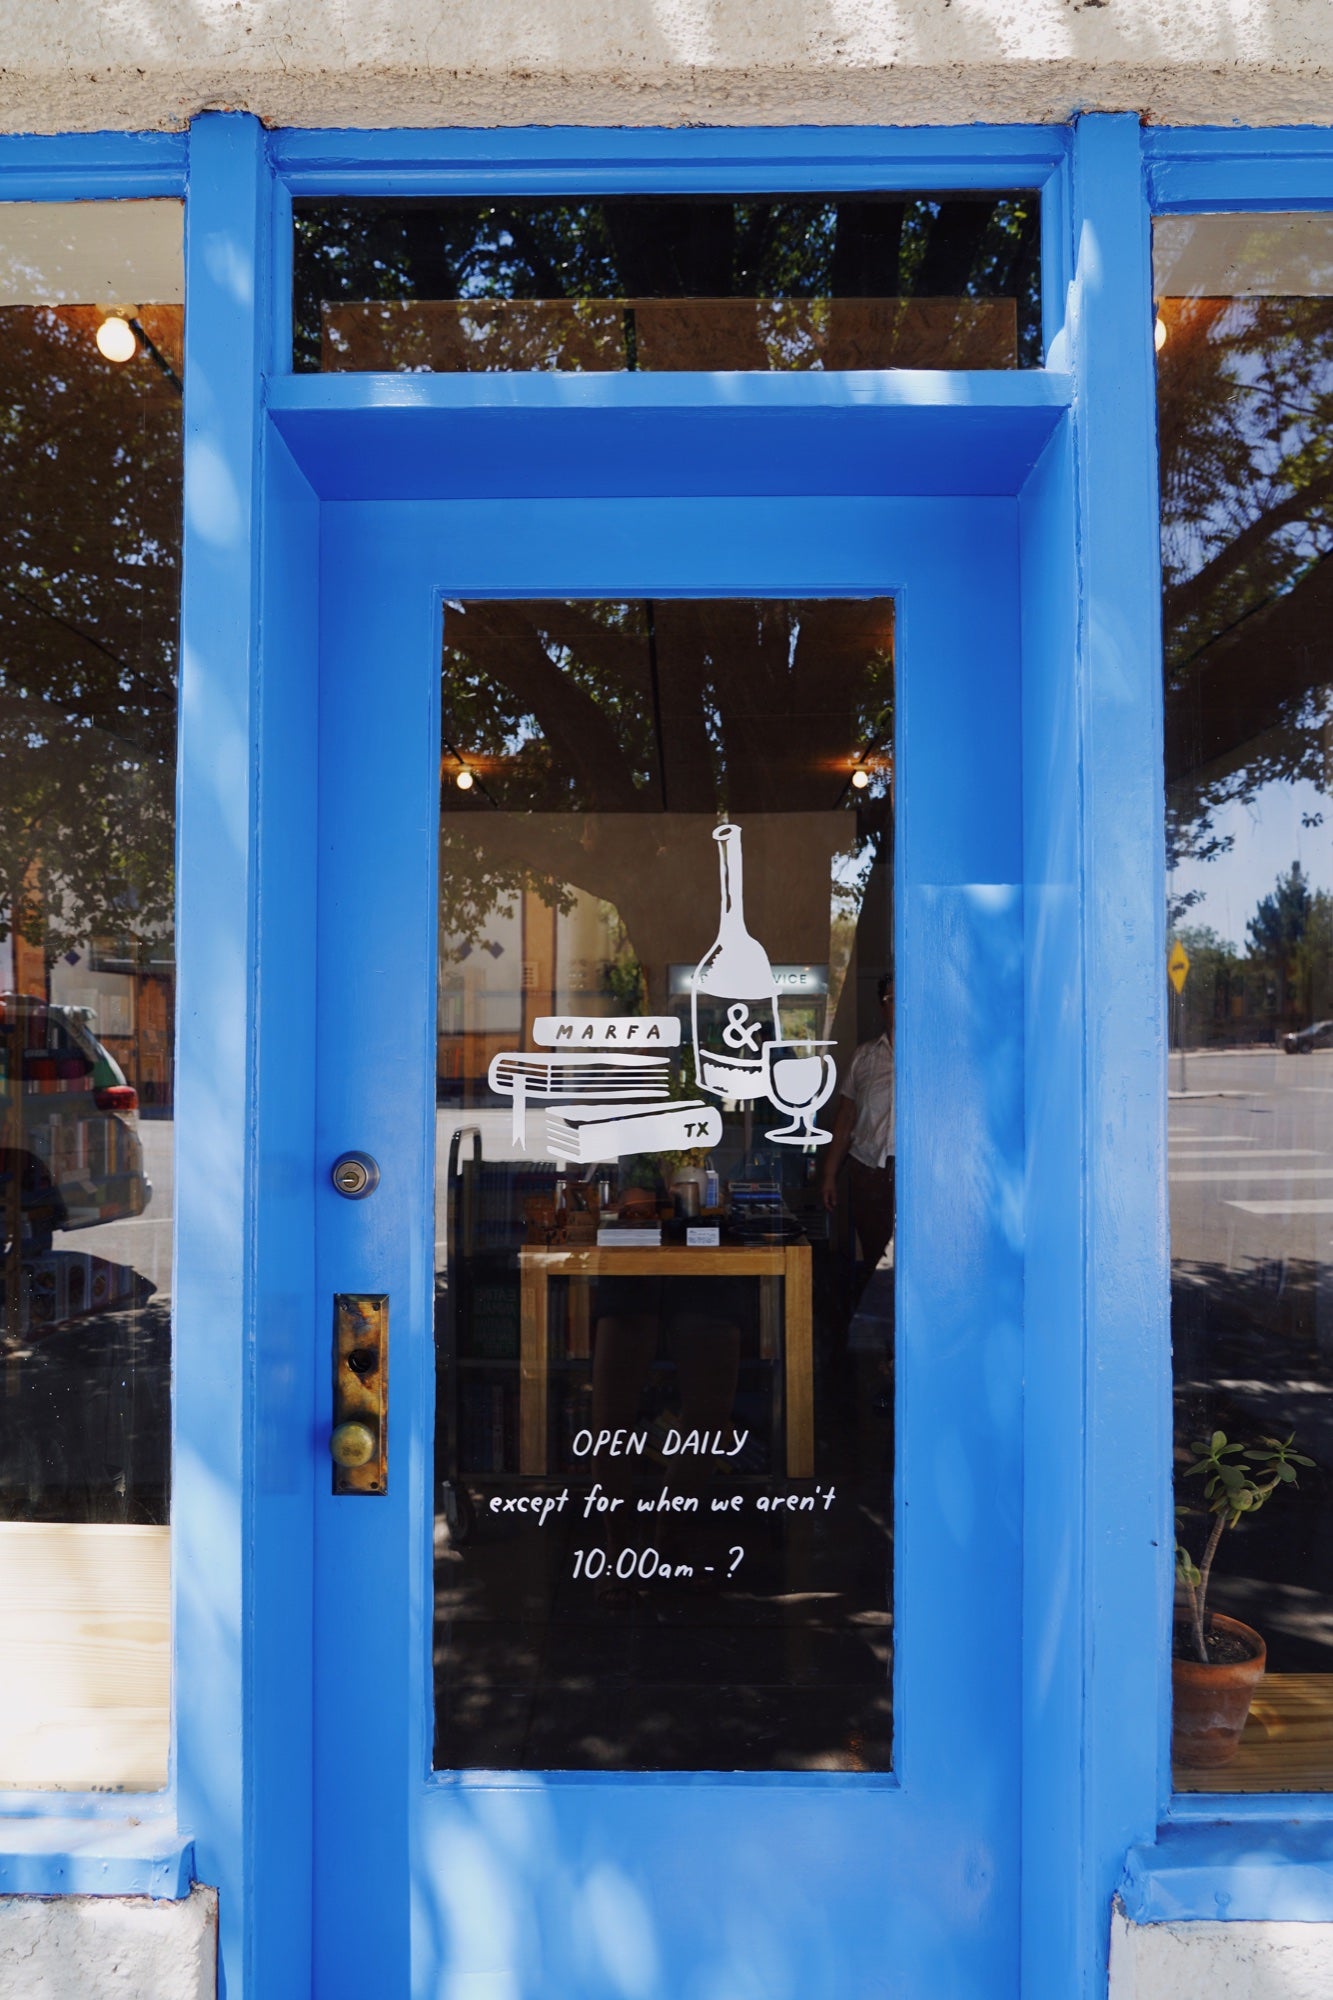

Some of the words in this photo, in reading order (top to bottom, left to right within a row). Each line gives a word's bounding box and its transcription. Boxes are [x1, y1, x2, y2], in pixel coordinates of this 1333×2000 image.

[555, 1024, 661, 1040] MARFA
[722, 1002, 762, 1051] &
[683, 1121, 710, 1138] TX
[572, 1429, 648, 1456] OPEN
[661, 1429, 749, 1456] DAILY
[489, 1488, 569, 1526] except
[583, 1483, 625, 1518] for
[636, 1486, 699, 1512] when
[710, 1495, 744, 1512] we
[756, 1485, 836, 1512] aren't
[572, 1547, 694, 1579] 10:00am
[726, 1545, 745, 1578] ?
